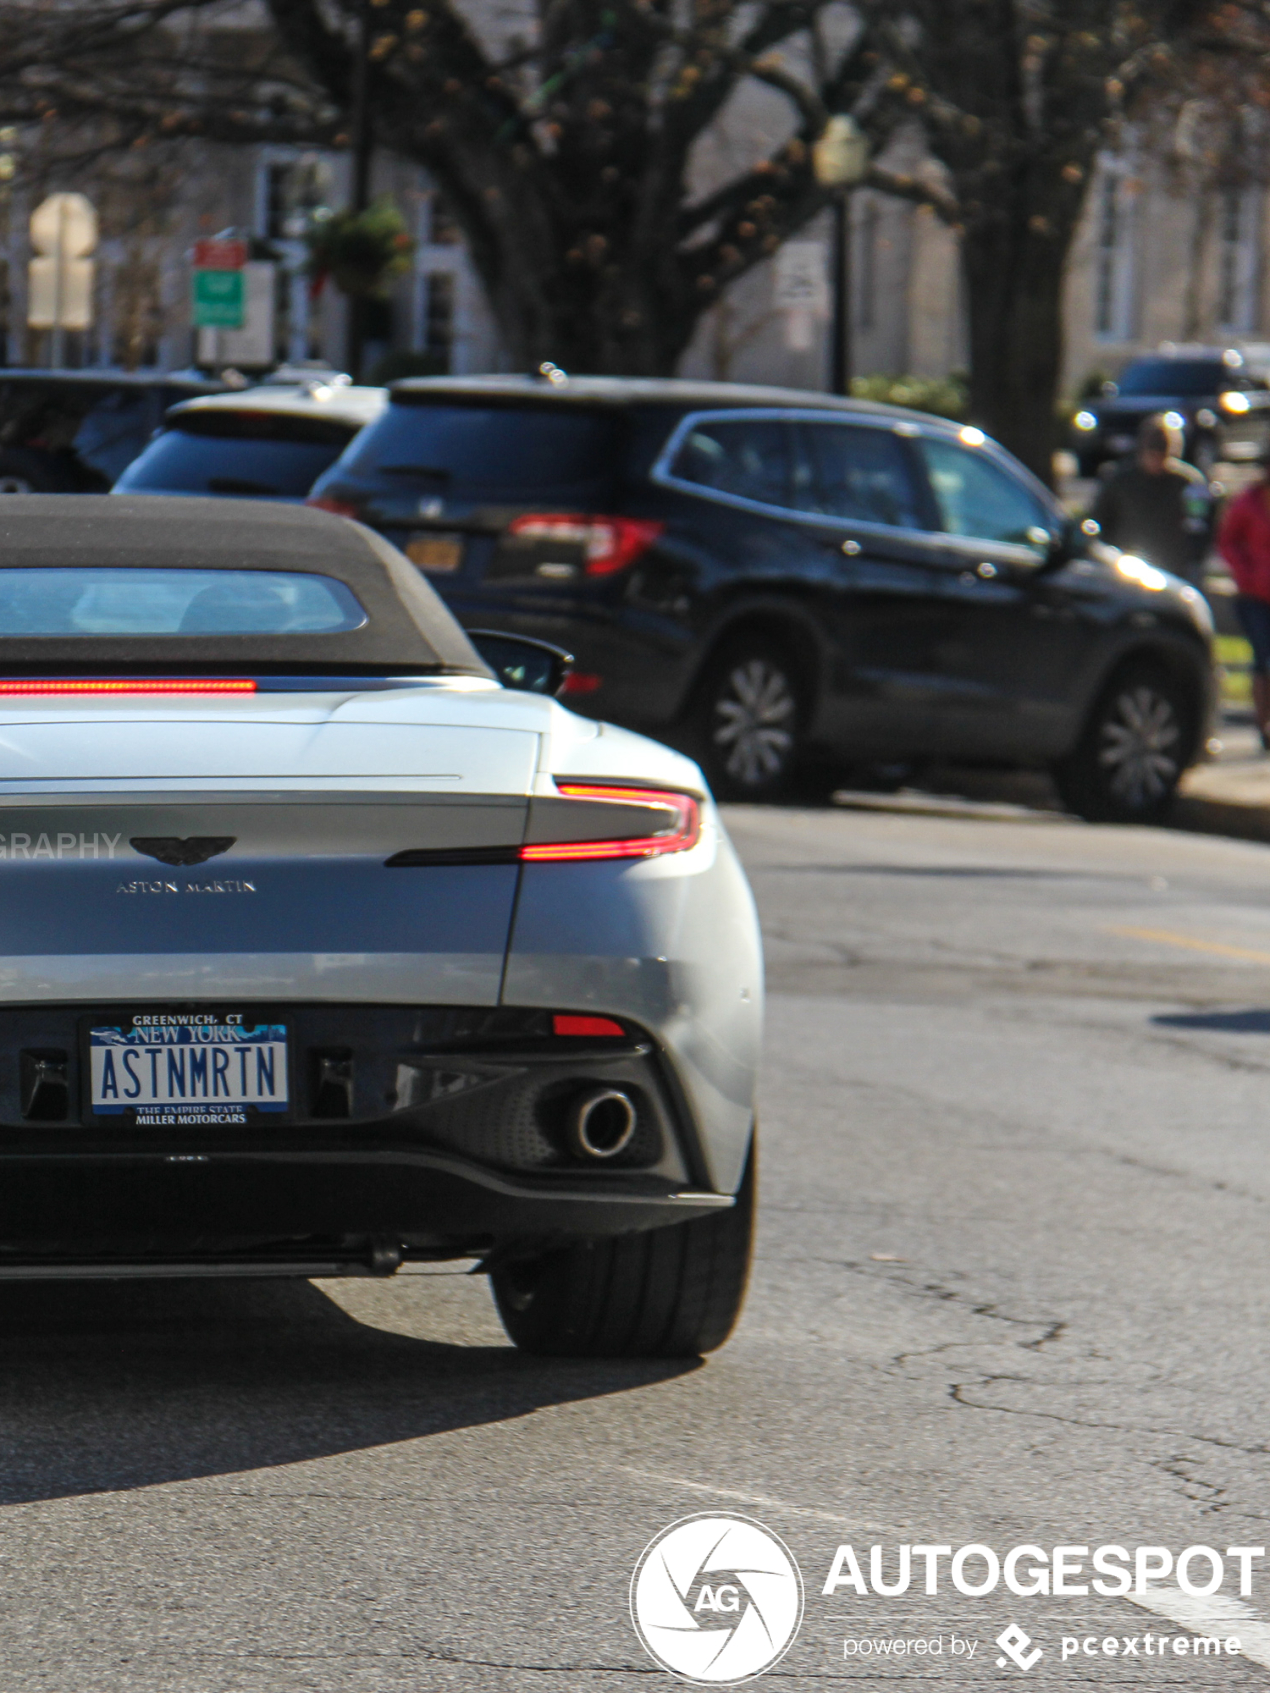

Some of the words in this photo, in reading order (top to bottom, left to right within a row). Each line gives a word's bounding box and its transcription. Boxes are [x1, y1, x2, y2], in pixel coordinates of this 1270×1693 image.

[116, 880, 178, 893] ASTON
[185, 880, 257, 893] MARTIN
[132, 1014, 219, 1026] GREENWICH,
[225, 1014, 243, 1025] CT
[134, 1026, 180, 1044] NEW
[187, 1025, 242, 1043] YORK
[101, 1046, 276, 1099] ASTNMRTN
[137, 1106, 161, 1114] THE
[164, 1106, 206, 1114] EMPIRE
[209, 1105, 243, 1113] STATE
[136, 1115, 175, 1125] MILLER
[178, 1113, 246, 1124] MOTORCARS
